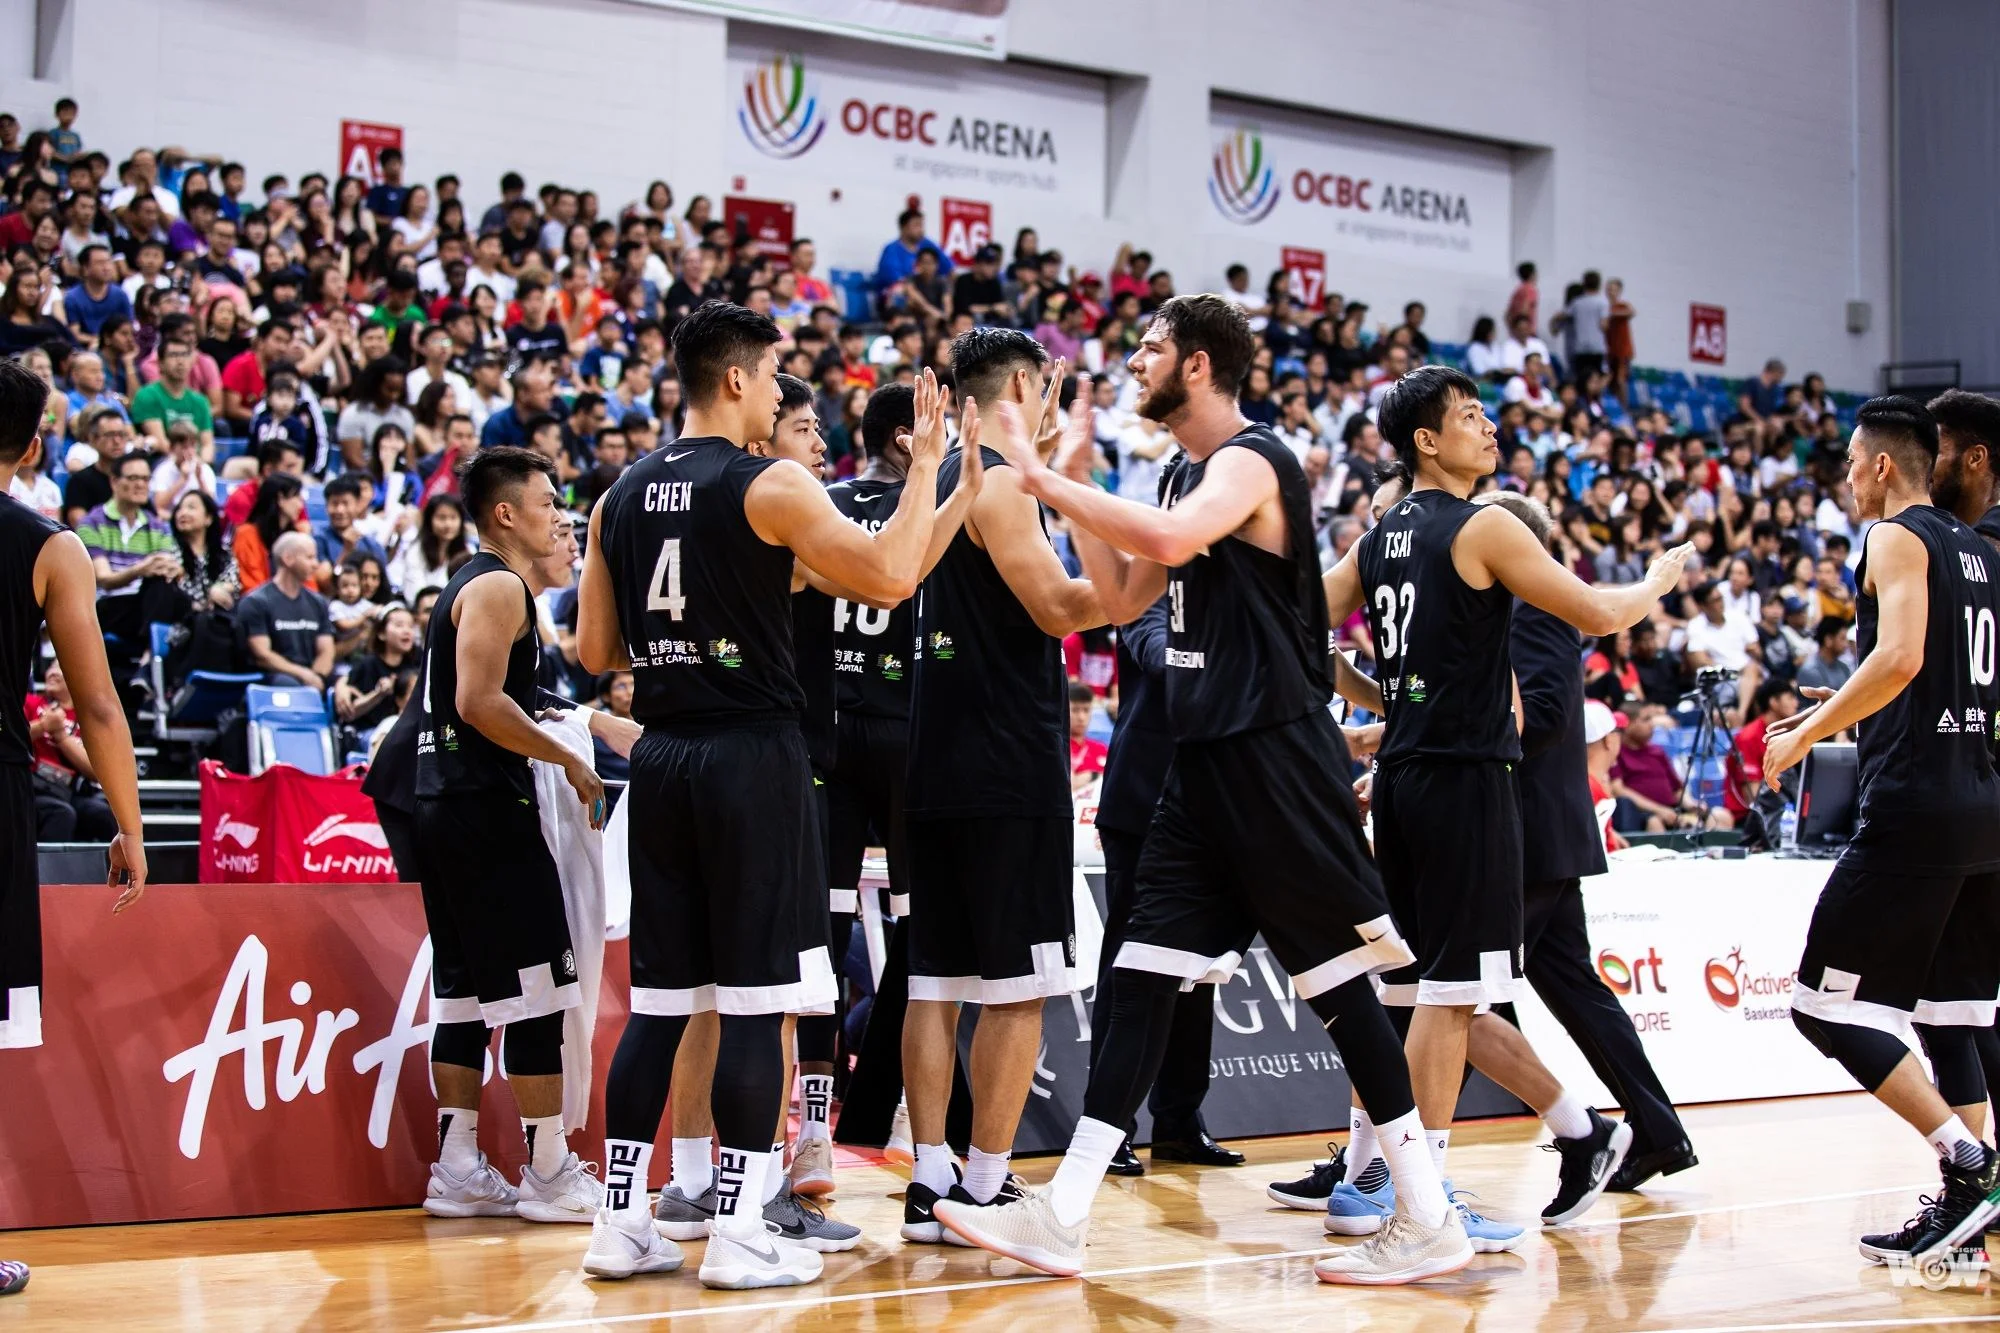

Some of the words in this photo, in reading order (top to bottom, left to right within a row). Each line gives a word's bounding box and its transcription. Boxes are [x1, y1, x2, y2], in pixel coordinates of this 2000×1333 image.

[841, 98, 937, 147] OCBC
[948, 115, 1057, 165] ARENA
[1292, 169, 1373, 213] OCBC
[1380, 184, 1471, 227] ARENA
[644, 481, 693, 512] CHEN
[1385, 529, 1414, 559] TSAI
[647, 538, 686, 621] 4
[1958, 551, 1988, 583] CHAI
[1374, 582, 1416, 660] 32
[665, 653, 703, 666] CAPITAL
[1964, 605, 1996, 687] 10
[303, 851, 398, 875] LI-NIN
[1744, 1006, 1792, 1021] Basketba
[1209, 1053, 1302, 1078] OUTIQUE
[1305, 1051, 1345, 1071] VIN
